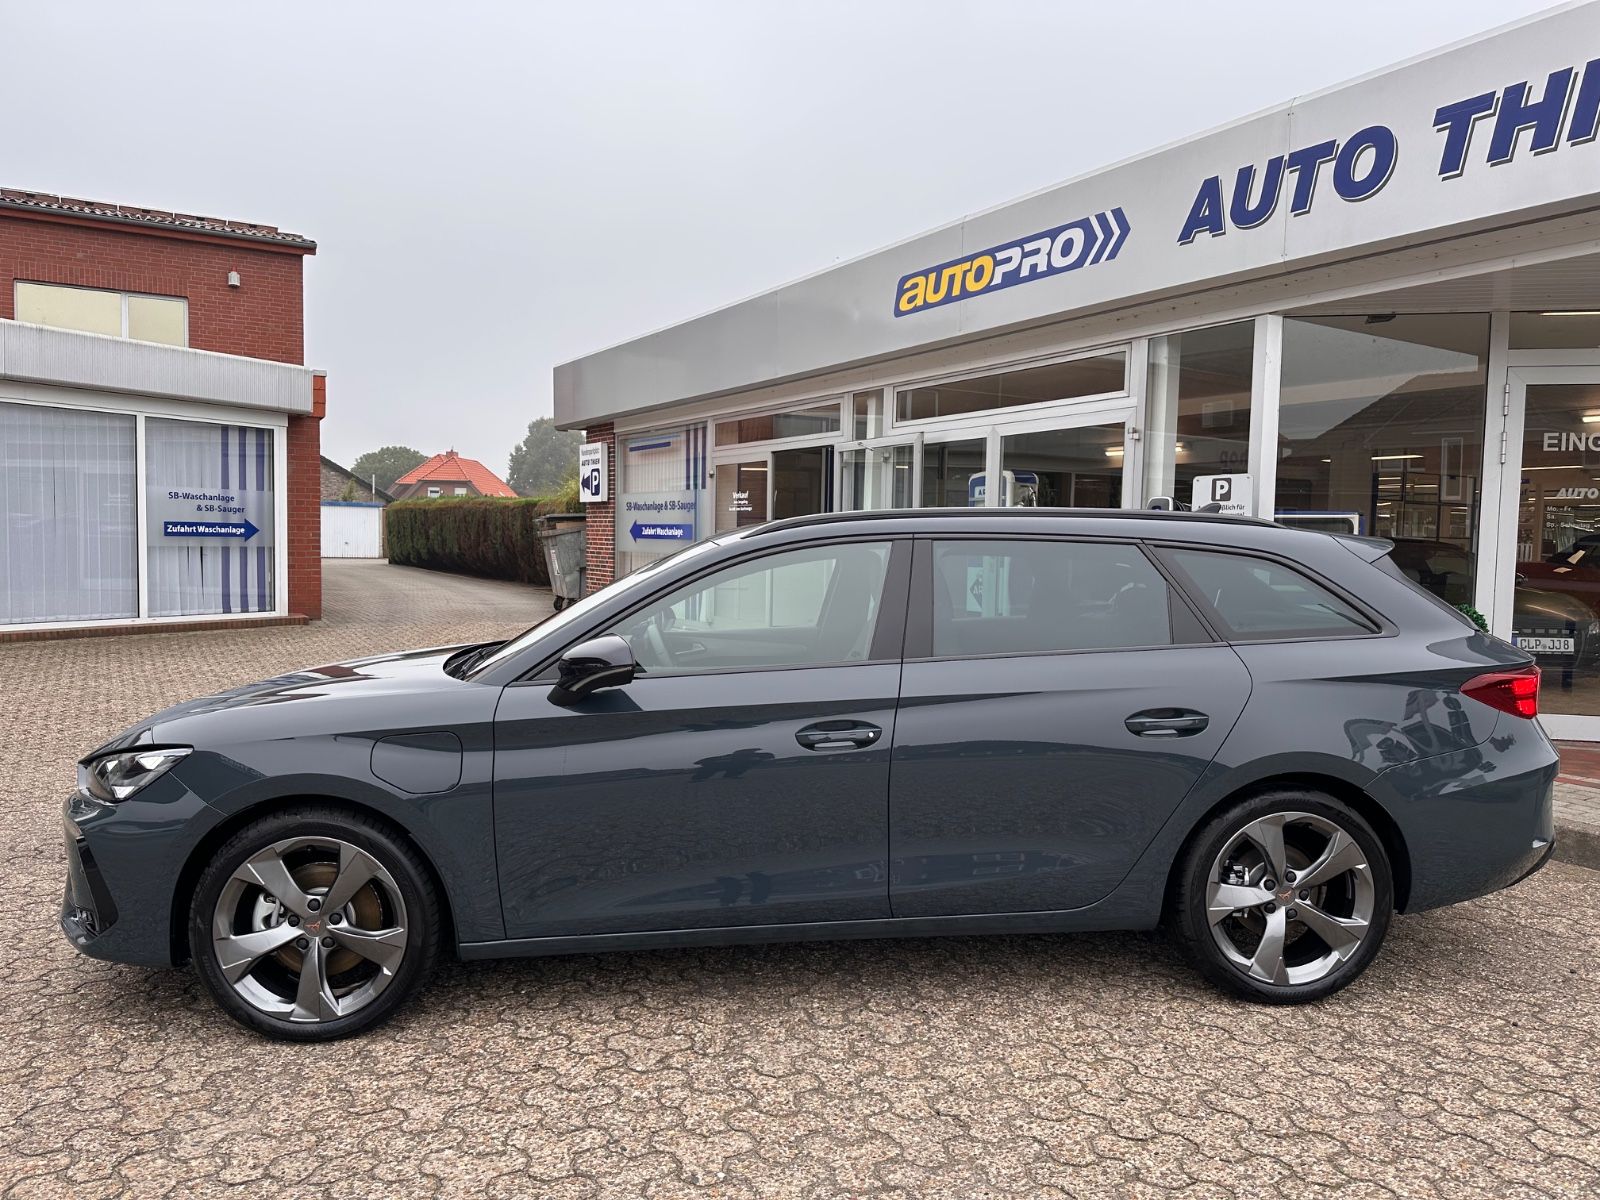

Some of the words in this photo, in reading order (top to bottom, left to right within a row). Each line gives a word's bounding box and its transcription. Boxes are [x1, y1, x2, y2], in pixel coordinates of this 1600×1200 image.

[1177, 125, 1398, 246] AUTO
[592, 471, 599, 494] P
[1215, 480, 1229, 500] P
[1556, 487, 1599, 499] AUTO
[168, 491, 235, 503] SB-Waschanlage
[196, 504, 203, 512] &
[204, 504, 245, 514] SB-Sauger
[626, 501, 664, 513] SB-Waschanlage
[664, 501, 669, 511] &
[167, 525, 197, 533] Zufahrt
[197, 526, 245, 535] Waschanlage
[641, 526, 656, 535] Zufahrt
[656, 527, 684, 537] Waschanlage
[1520, 639, 1541, 649] CLP
